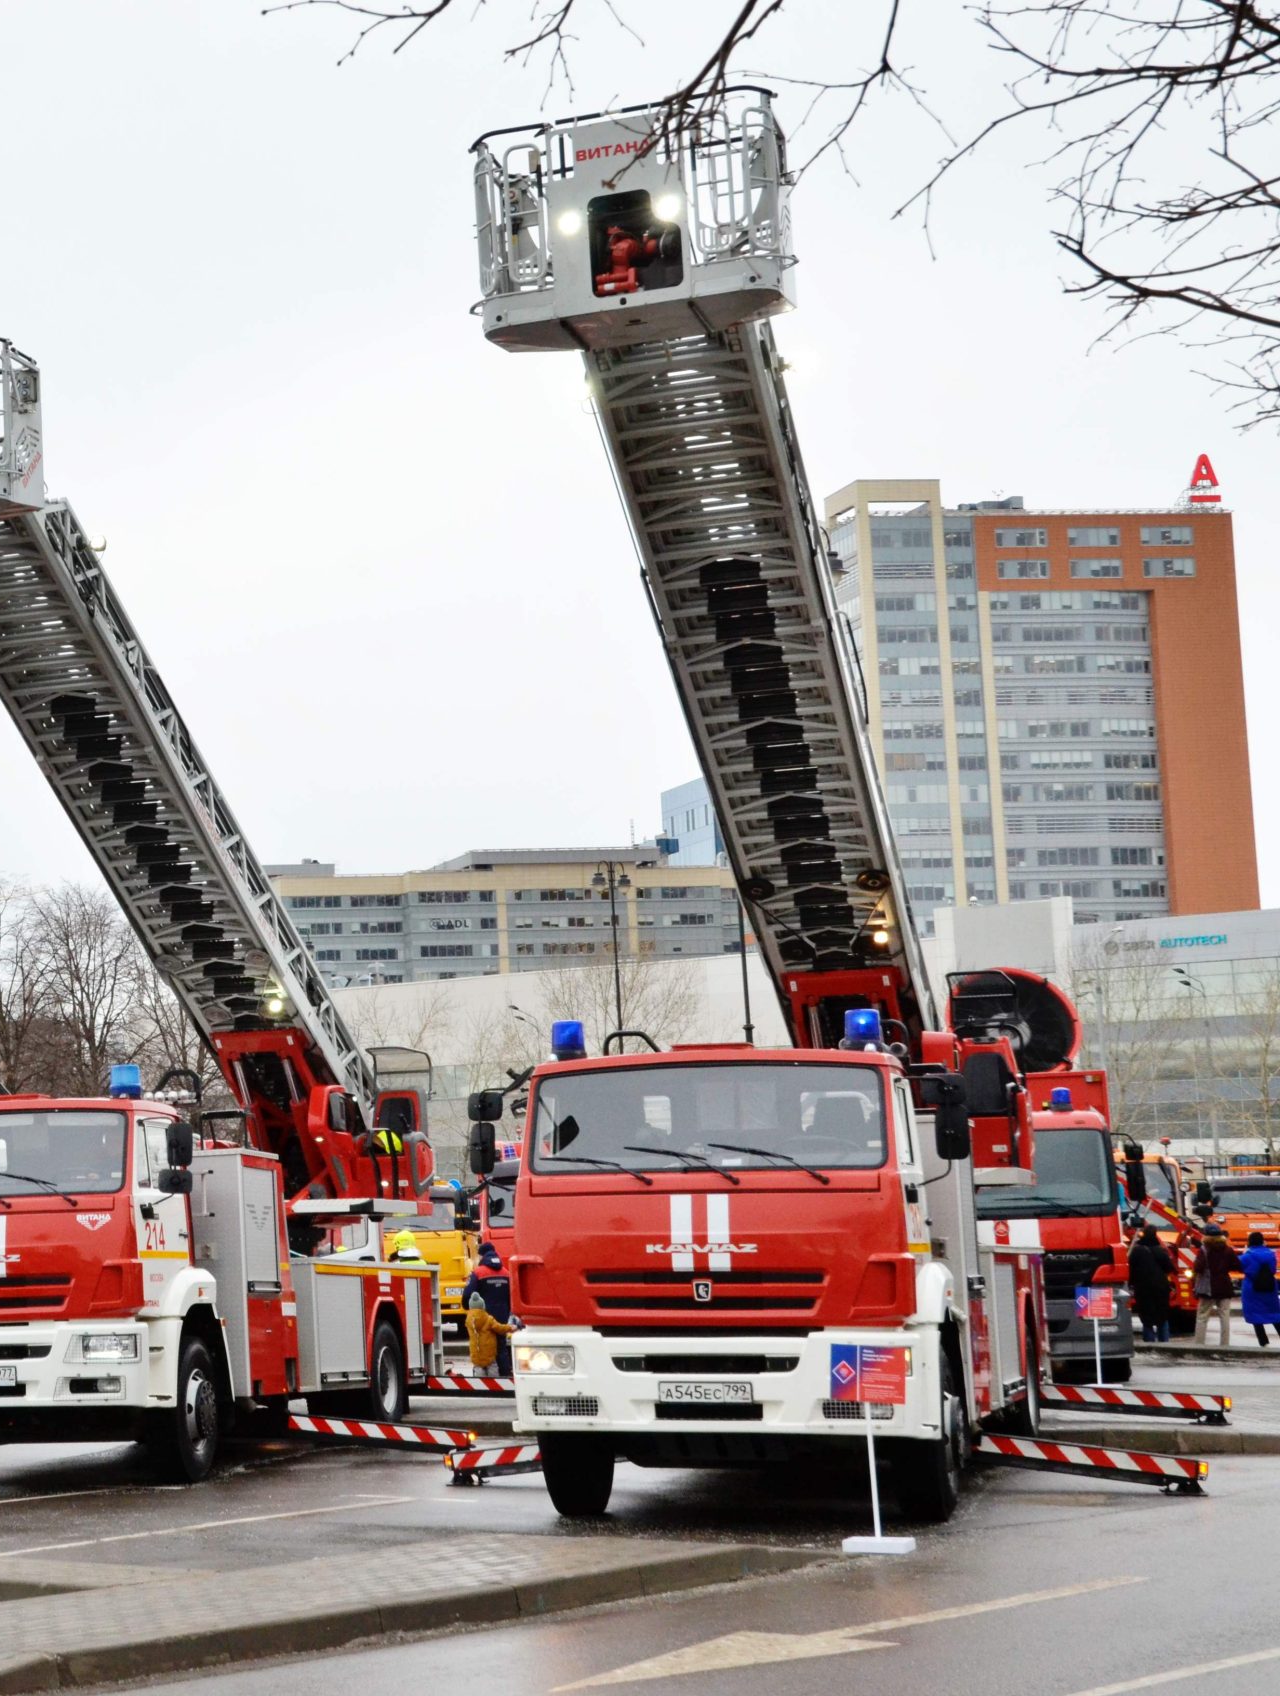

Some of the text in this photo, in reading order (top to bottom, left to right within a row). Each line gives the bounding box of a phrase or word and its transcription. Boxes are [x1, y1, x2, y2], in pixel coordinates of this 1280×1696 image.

[448, 919, 470, 929] ADL
[1159, 934, 1228, 949] AUTOTECH
[145, 1222, 166, 1250] 214
[646, 1244, 759, 1254] KAMAZ
